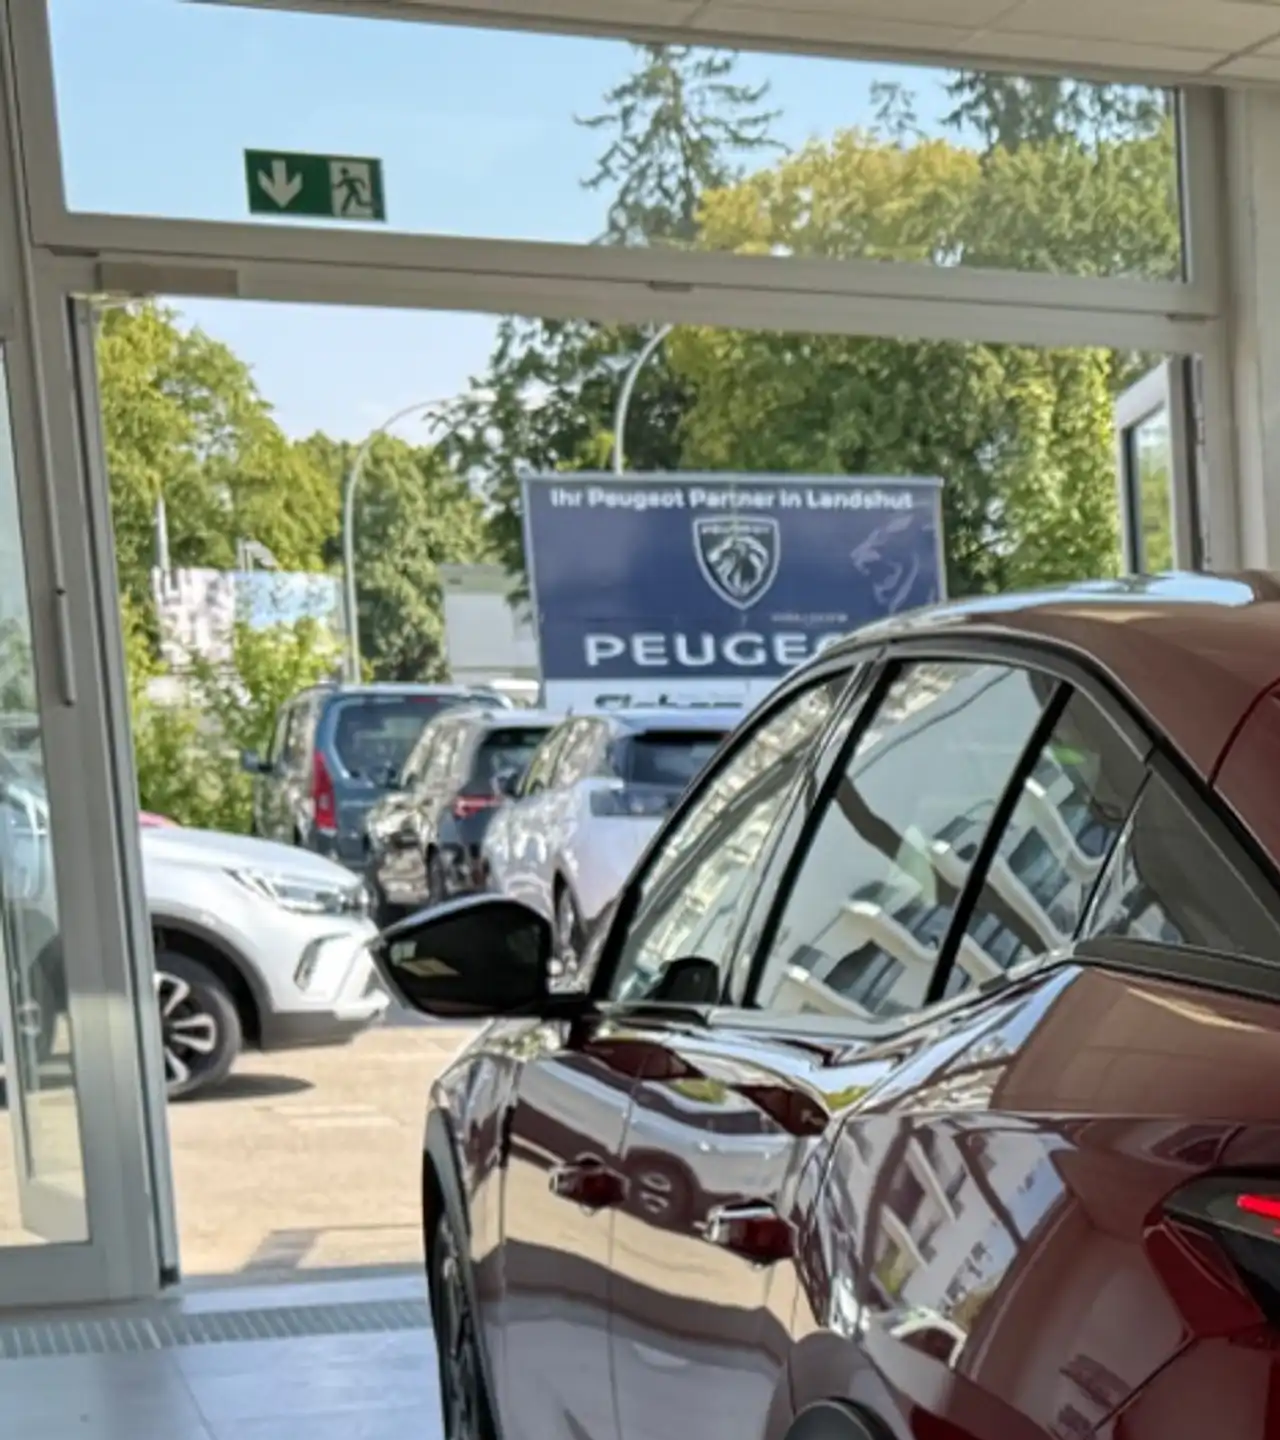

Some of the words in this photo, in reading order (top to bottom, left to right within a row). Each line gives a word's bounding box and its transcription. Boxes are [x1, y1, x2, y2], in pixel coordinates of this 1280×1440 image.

[550, 487, 582, 508] Ihr
[586, 486, 686, 512] Peugeot
[688, 487, 776, 509] Partner
[780, 489, 802, 508] in
[805, 488, 913, 510] Landshut
[584, 632, 835, 667] PEUGE
